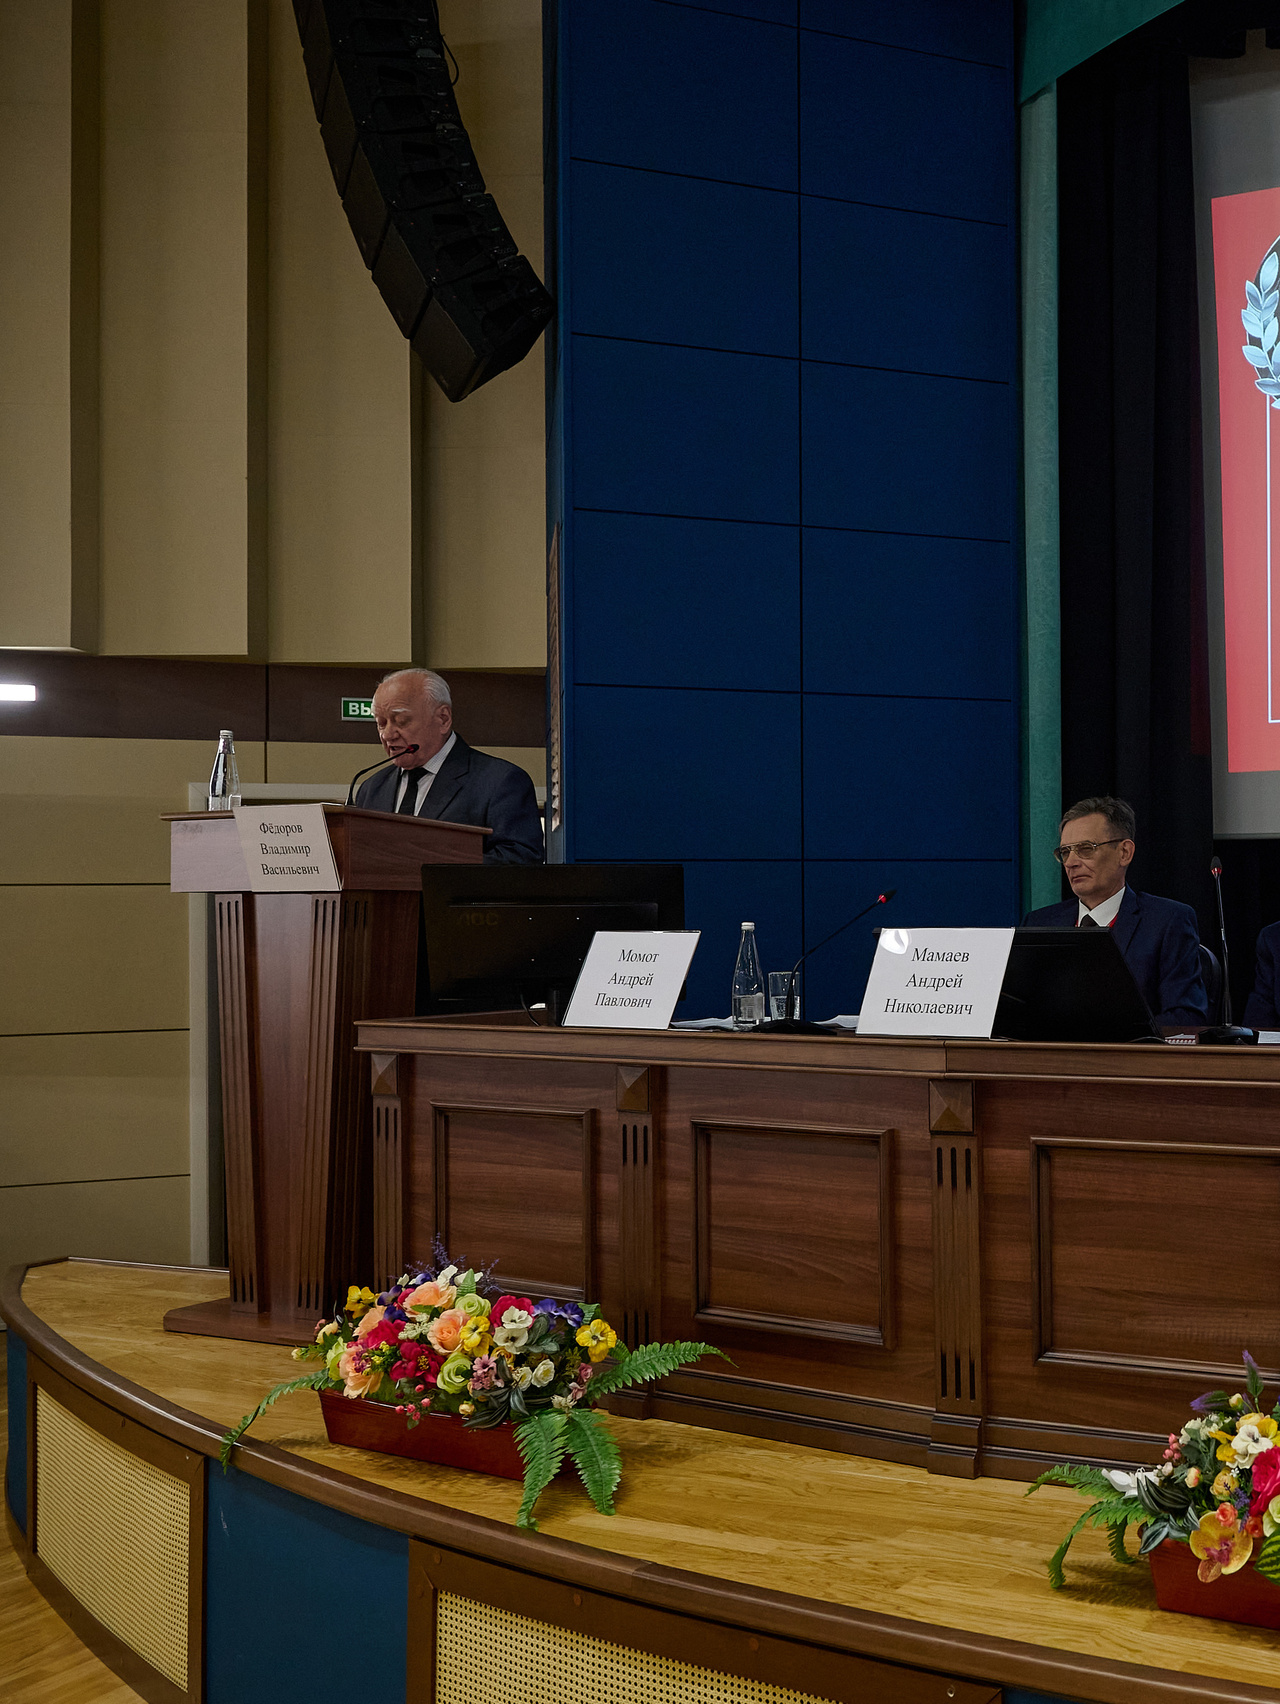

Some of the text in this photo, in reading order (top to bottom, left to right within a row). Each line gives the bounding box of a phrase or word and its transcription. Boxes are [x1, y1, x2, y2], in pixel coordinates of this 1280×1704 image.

[259, 822, 303, 837] Фёдоров
[260, 842, 311, 857] Владимир
[261, 863, 320, 876] Васильевич
[618, 949, 659, 963] Момот
[911, 947, 970, 963] Мамаев
[608, 972, 654, 989] Андрей
[905, 973, 963, 992] Андрей
[595, 992, 652, 1008] Павлович
[884, 998, 973, 1015] Николаевич
